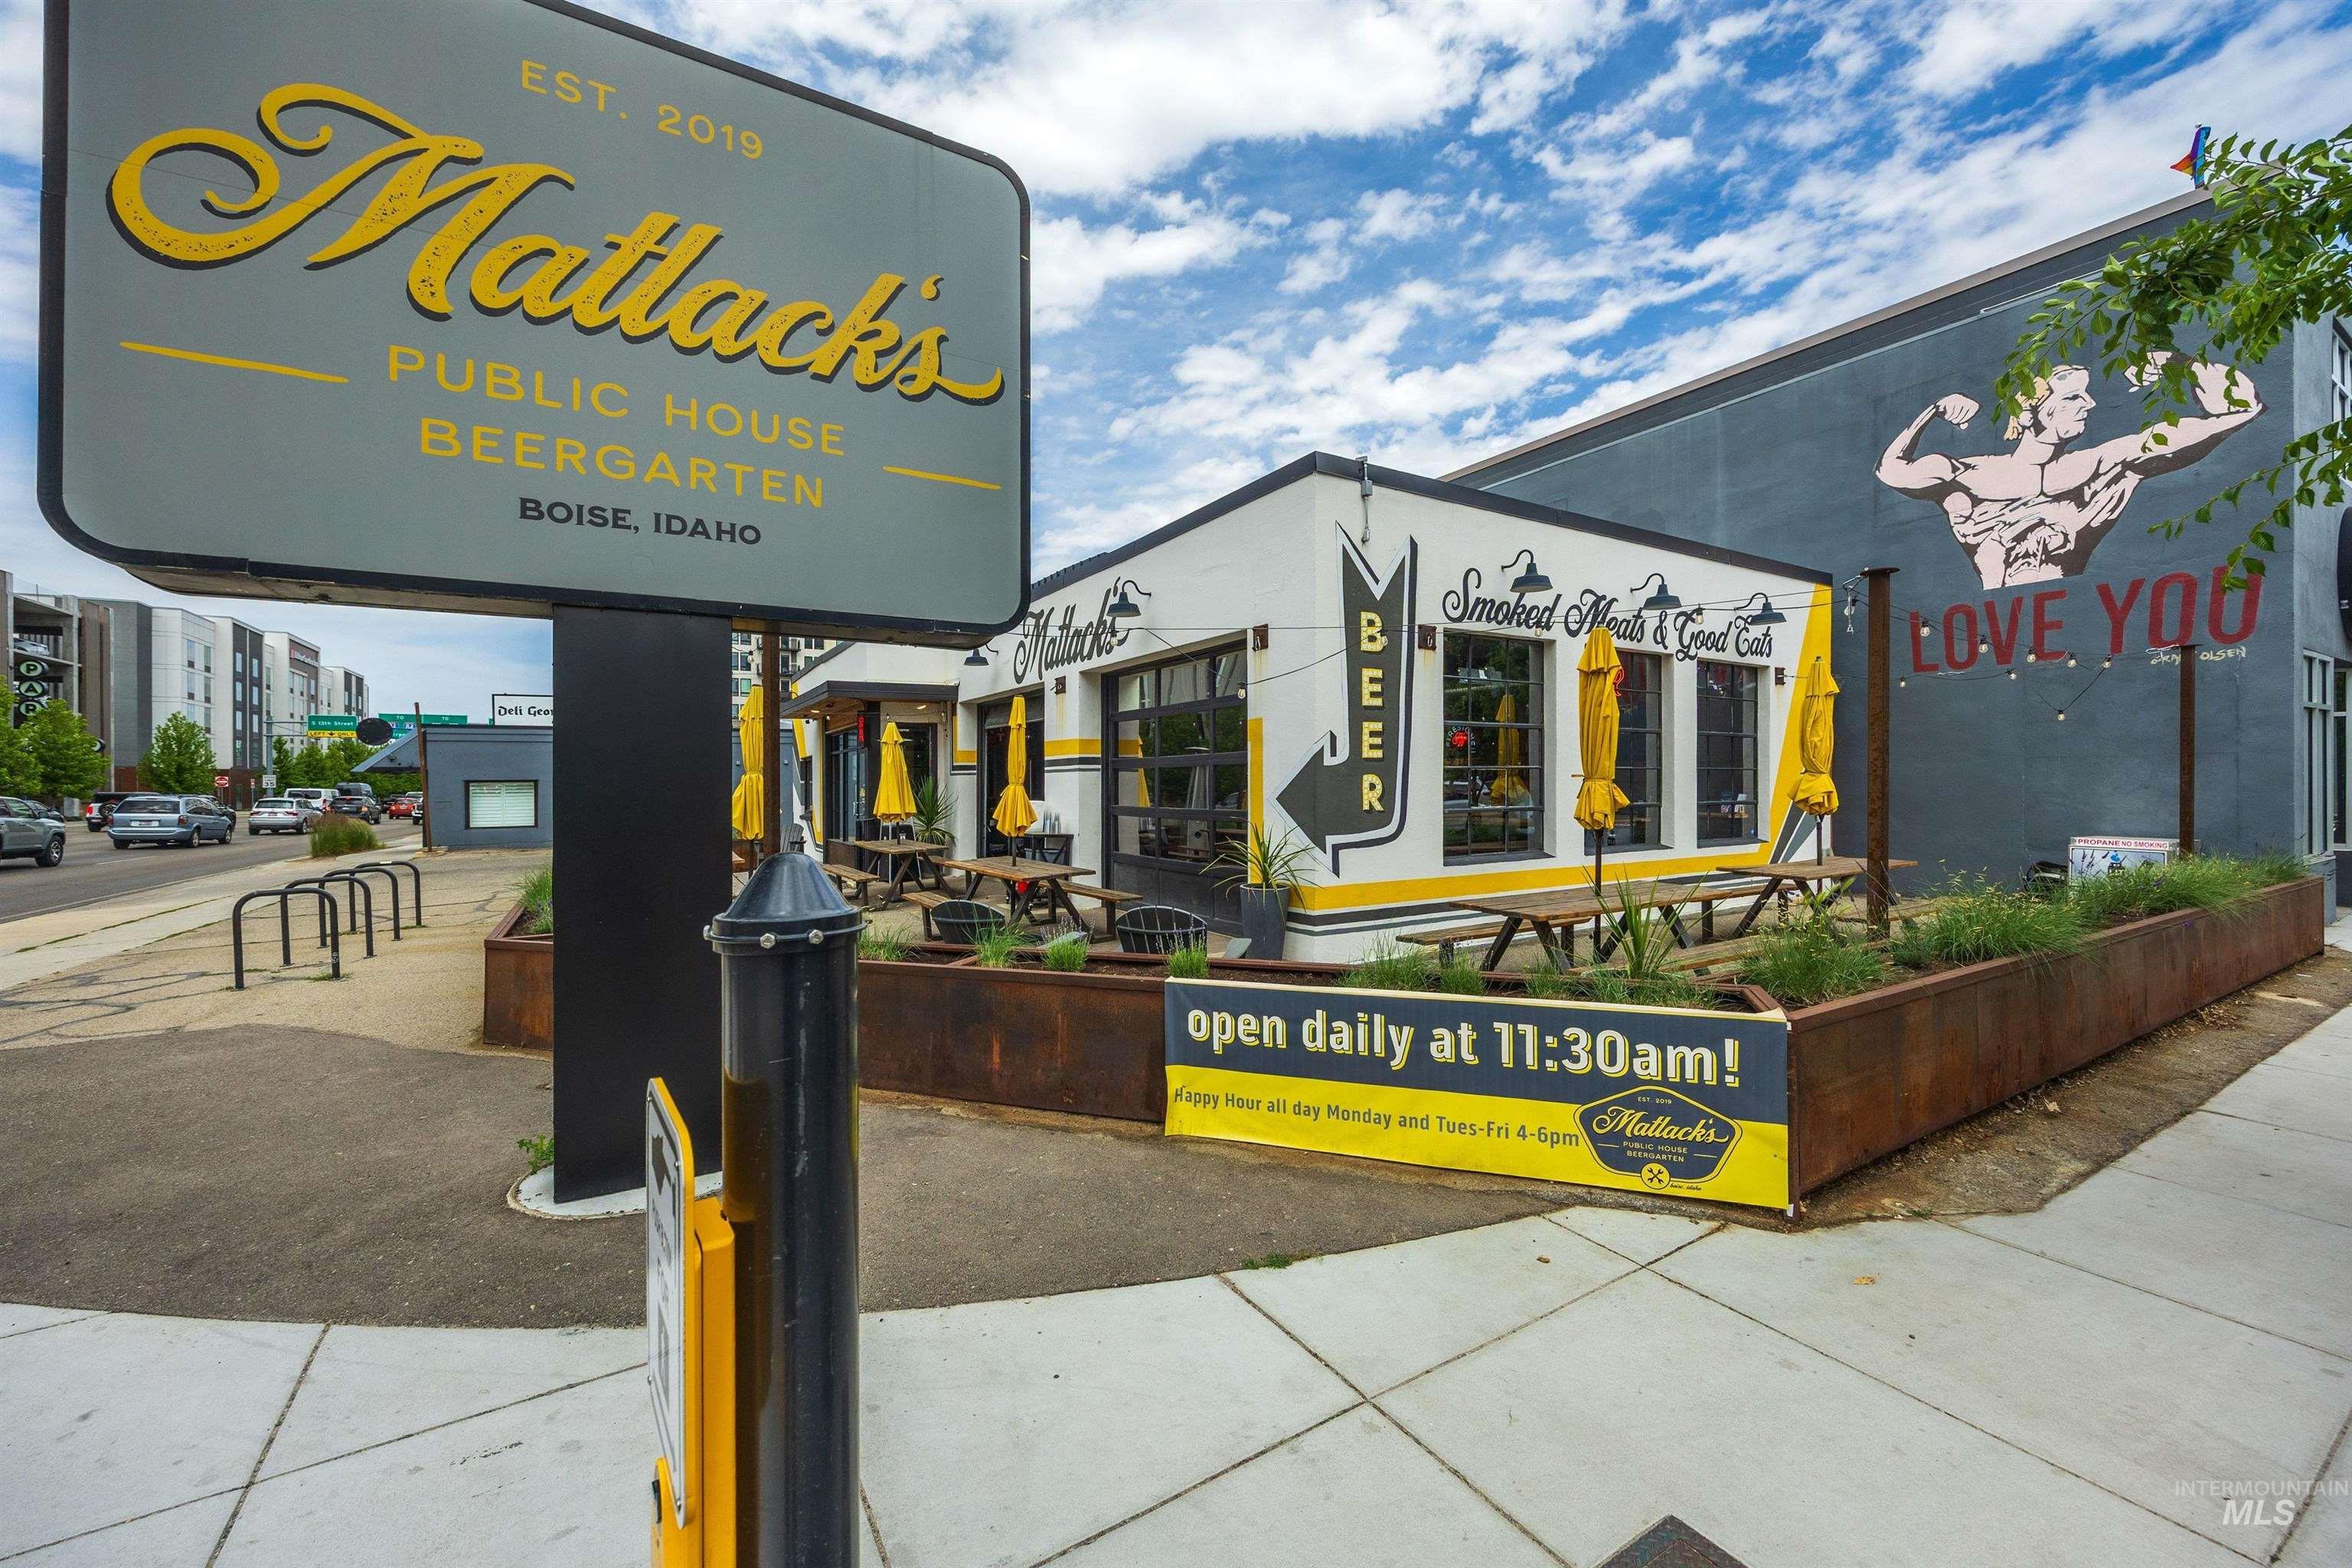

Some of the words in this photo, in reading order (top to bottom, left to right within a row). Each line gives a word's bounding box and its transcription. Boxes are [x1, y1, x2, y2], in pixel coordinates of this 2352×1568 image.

[521, 60, 627, 119] EST.
[657, 105, 763, 159] 2019
[106, 83, 1004, 406] Matlack's
[388, 345, 630, 418] PUBLIC
[665, 394, 844, 456] HOUSE
[420, 417, 823, 508] BEERGARTEN
[518, 497, 640, 534] BOISE,
[653, 513, 762, 546] IDAHO
[1013, 577, 1130, 684] Matlack's
[1442, 567, 1563, 632] Smoked
[1564, 588, 1646, 643] Meats
[1652, 610, 1668, 650] &
[1674, 611, 1733, 662] Good
[1734, 614, 1773, 658] Eats
[1909, 589, 2068, 674] LOVE
[2096, 565, 2265, 655] YOU
[2200, 645, 2247, 661] OLSEN
[24, 663, 38, 714] PAR
[498, 705, 523, 717] Deli
[1361, 611, 1384, 812] BEER
[2078, 838, 2121, 847] PROPANE
[1187, 1008, 1286, 1054] open
[1302, 1009, 1414, 1070] daily
[1429, 1022, 1480, 1065] at
[1493, 1021, 1740, 1088] 11:30am!
[1174, 1087, 1220, 1109] Happy
[1225, 1093, 1262, 1111] Hour
[1266, 1099, 1286, 1114] all
[1292, 1101, 1321, 1122] day
[1327, 1104, 1392, 1129] Monday
[1398, 1114, 1429, 1131] and
[1436, 1116, 1510, 1139] Tues-Fri
[1517, 1124, 1579, 1148] 4-6pm
[1592, 1106, 1730, 1144] Matlack's
[1622, 1141, 1654, 1150] PUBLIC
[1658, 1145, 1687, 1154] HOUSE
[1626, 1150, 1685, 1162] BEERGARTEN
